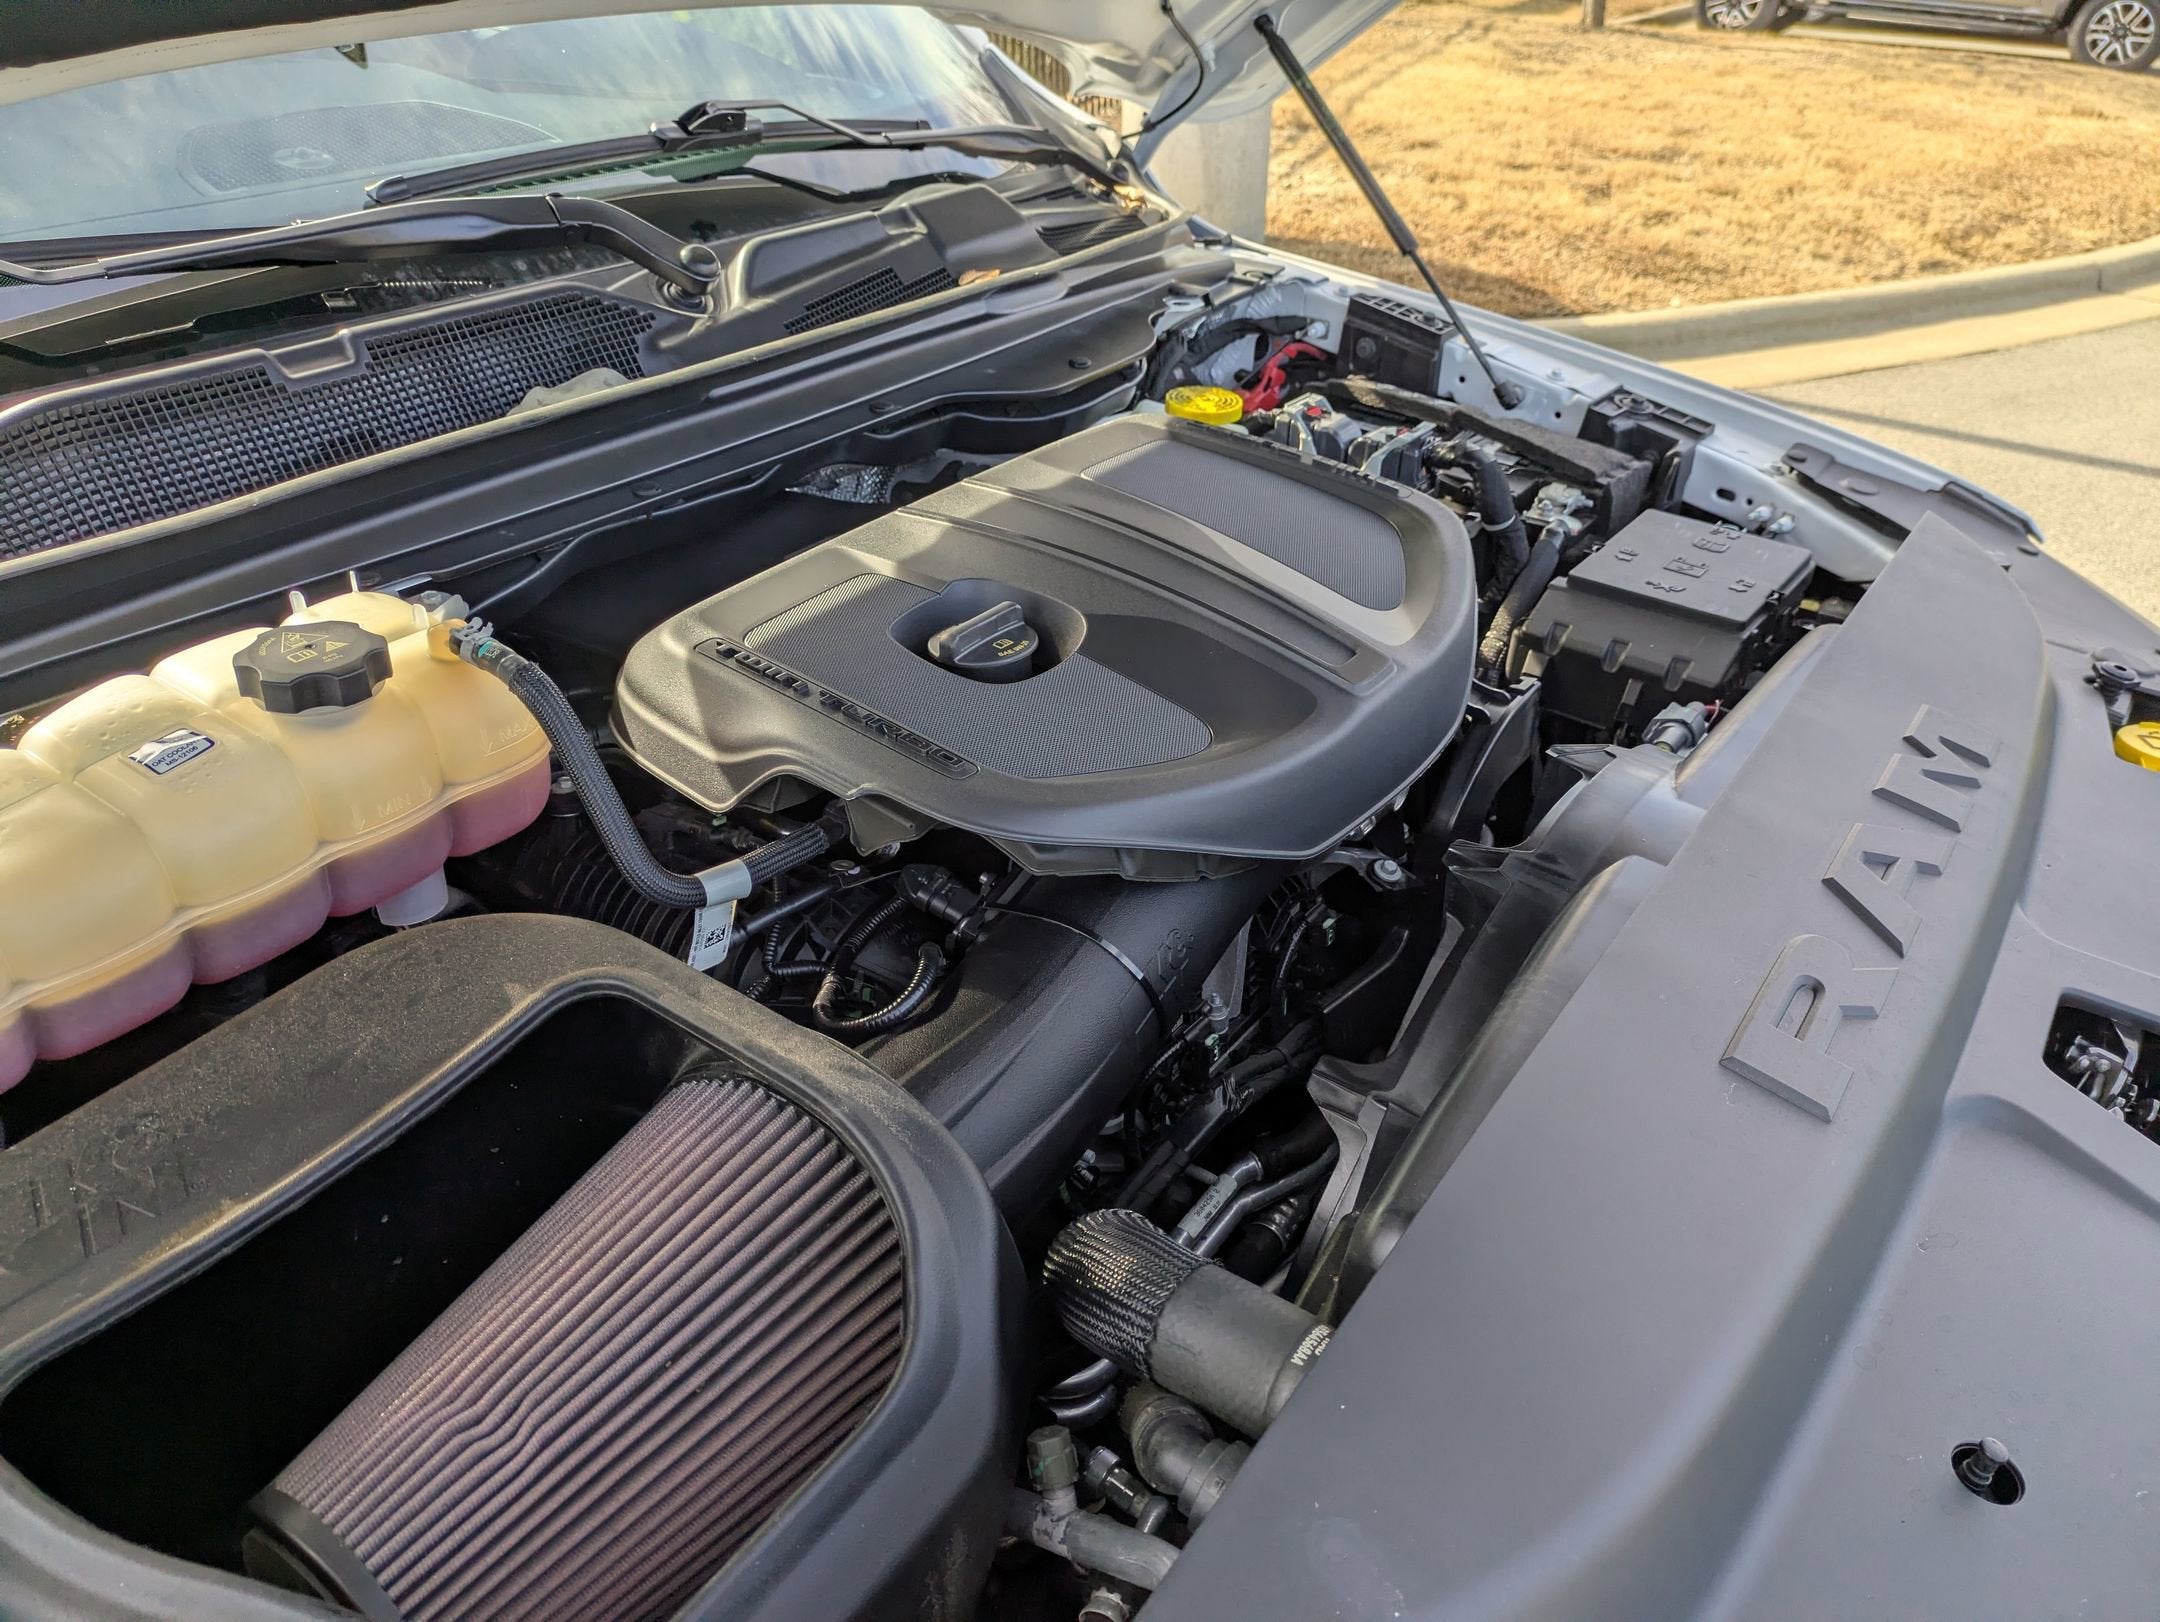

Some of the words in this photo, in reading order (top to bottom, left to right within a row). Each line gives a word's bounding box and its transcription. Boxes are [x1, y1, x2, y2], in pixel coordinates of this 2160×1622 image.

[819, 690, 965, 769] TURBO
[151, 756, 167, 767] OAT
[377, 793, 412, 817] MIN
[1720, 703, 2000, 1123] RAM
